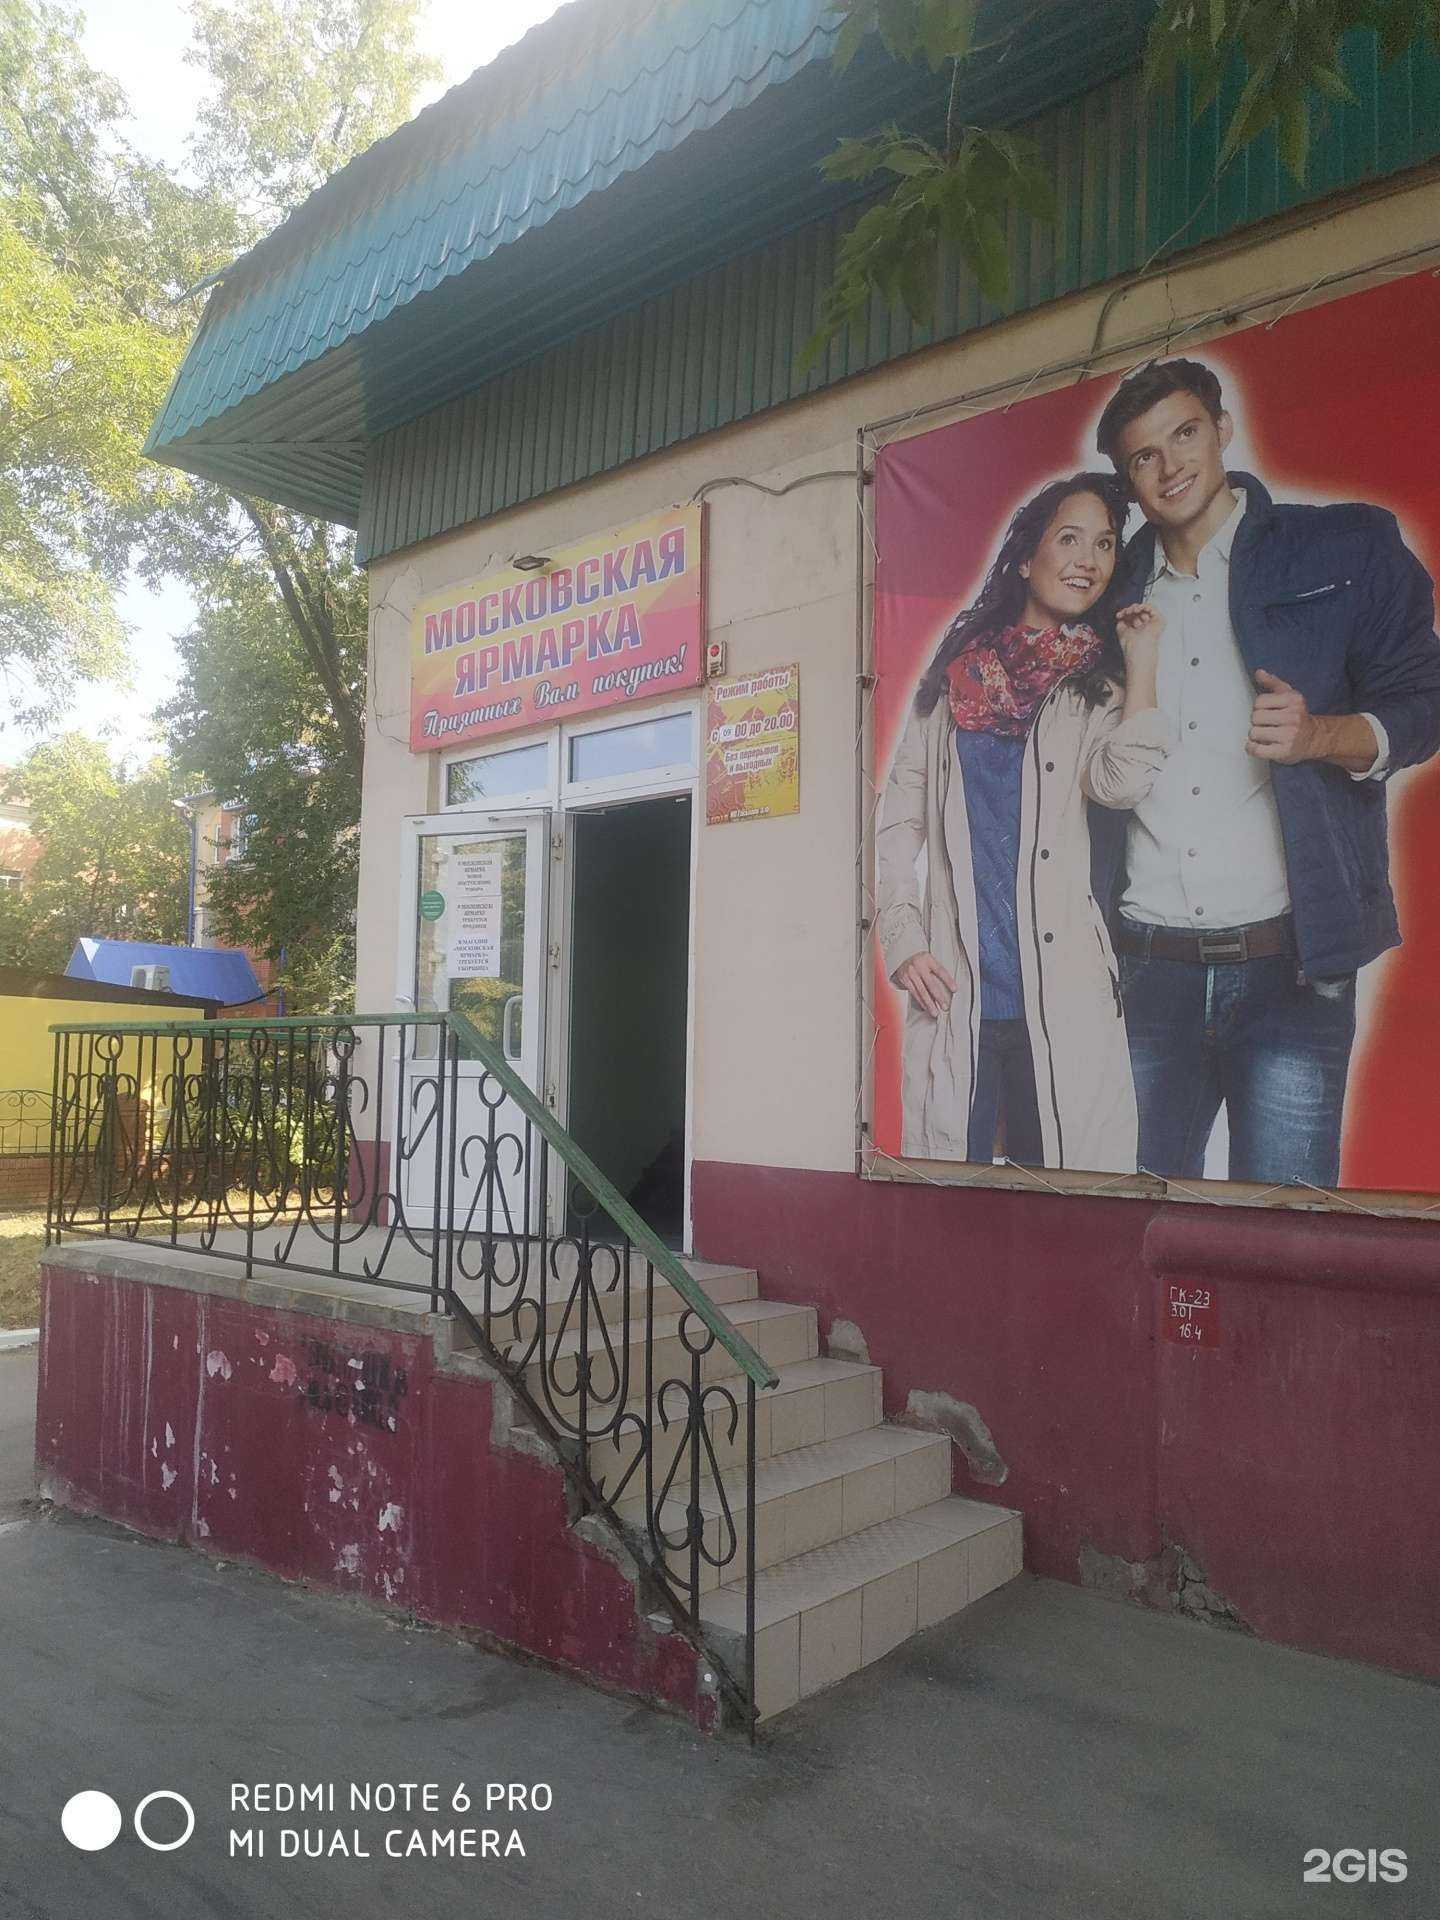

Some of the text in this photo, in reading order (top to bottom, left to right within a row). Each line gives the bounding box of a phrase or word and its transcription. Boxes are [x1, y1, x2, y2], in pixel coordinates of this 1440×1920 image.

[424, 527, 686, 655] МОСКОВСКАЯ
[423, 644, 687, 737] Приятных Вам покупок!
[453, 602, 643, 698] ЯРМАРКА
[751, 674, 789, 695] работы
[749, 722, 762, 737] до
